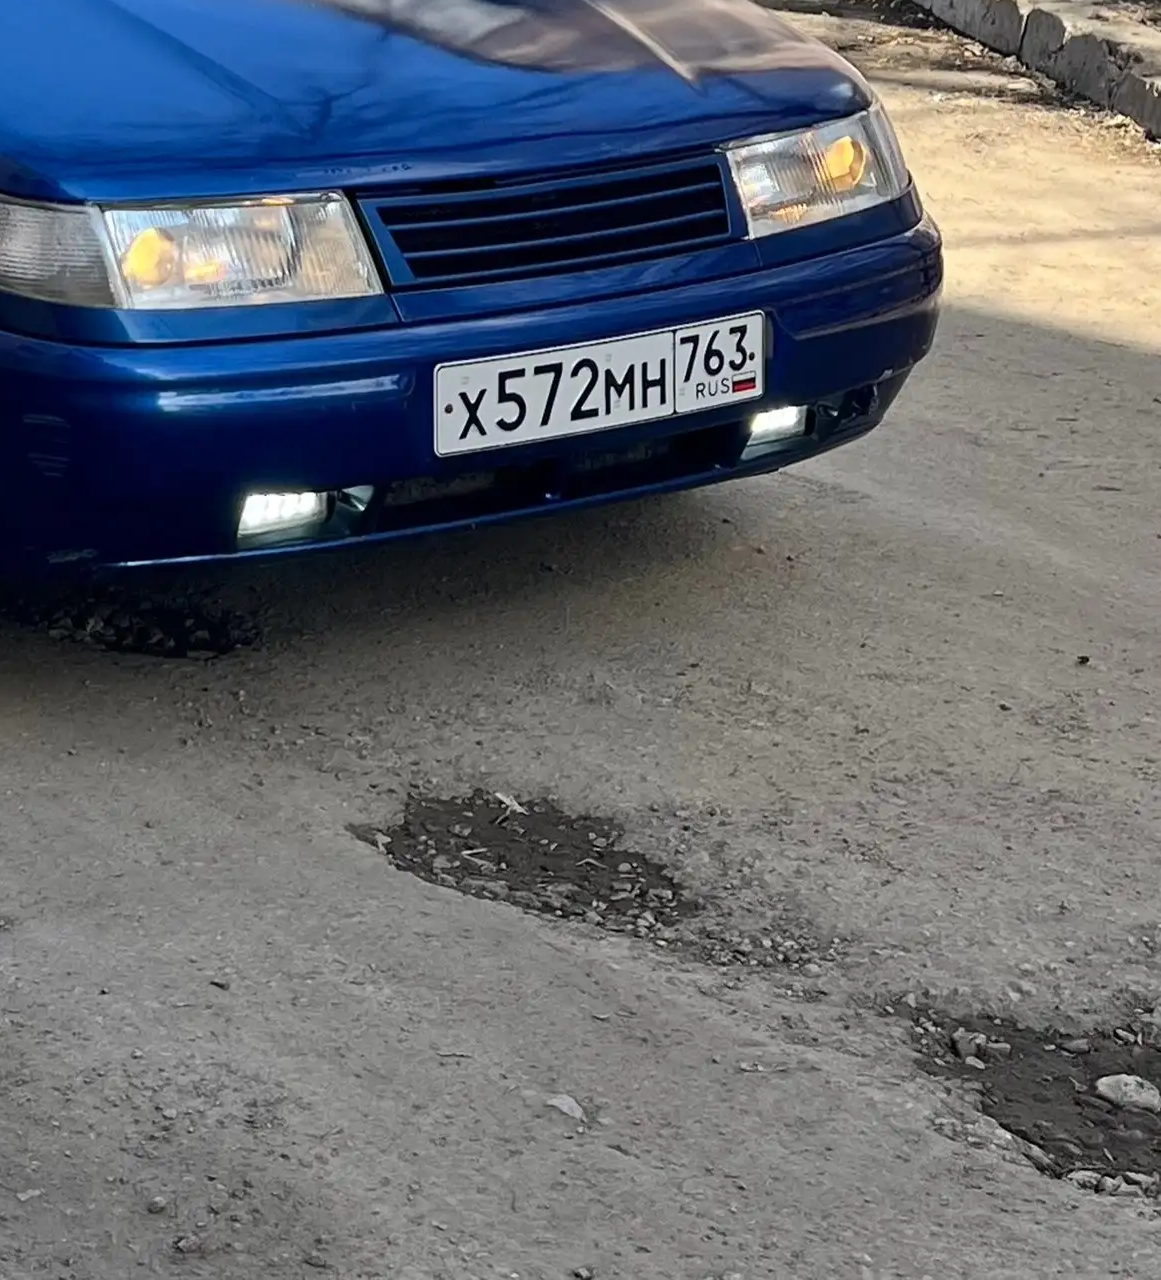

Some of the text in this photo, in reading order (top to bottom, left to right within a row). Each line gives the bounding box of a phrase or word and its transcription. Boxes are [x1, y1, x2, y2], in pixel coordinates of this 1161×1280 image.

[458, 324, 749, 440] Х572МН 763
[695, 377, 731, 400] RUS
